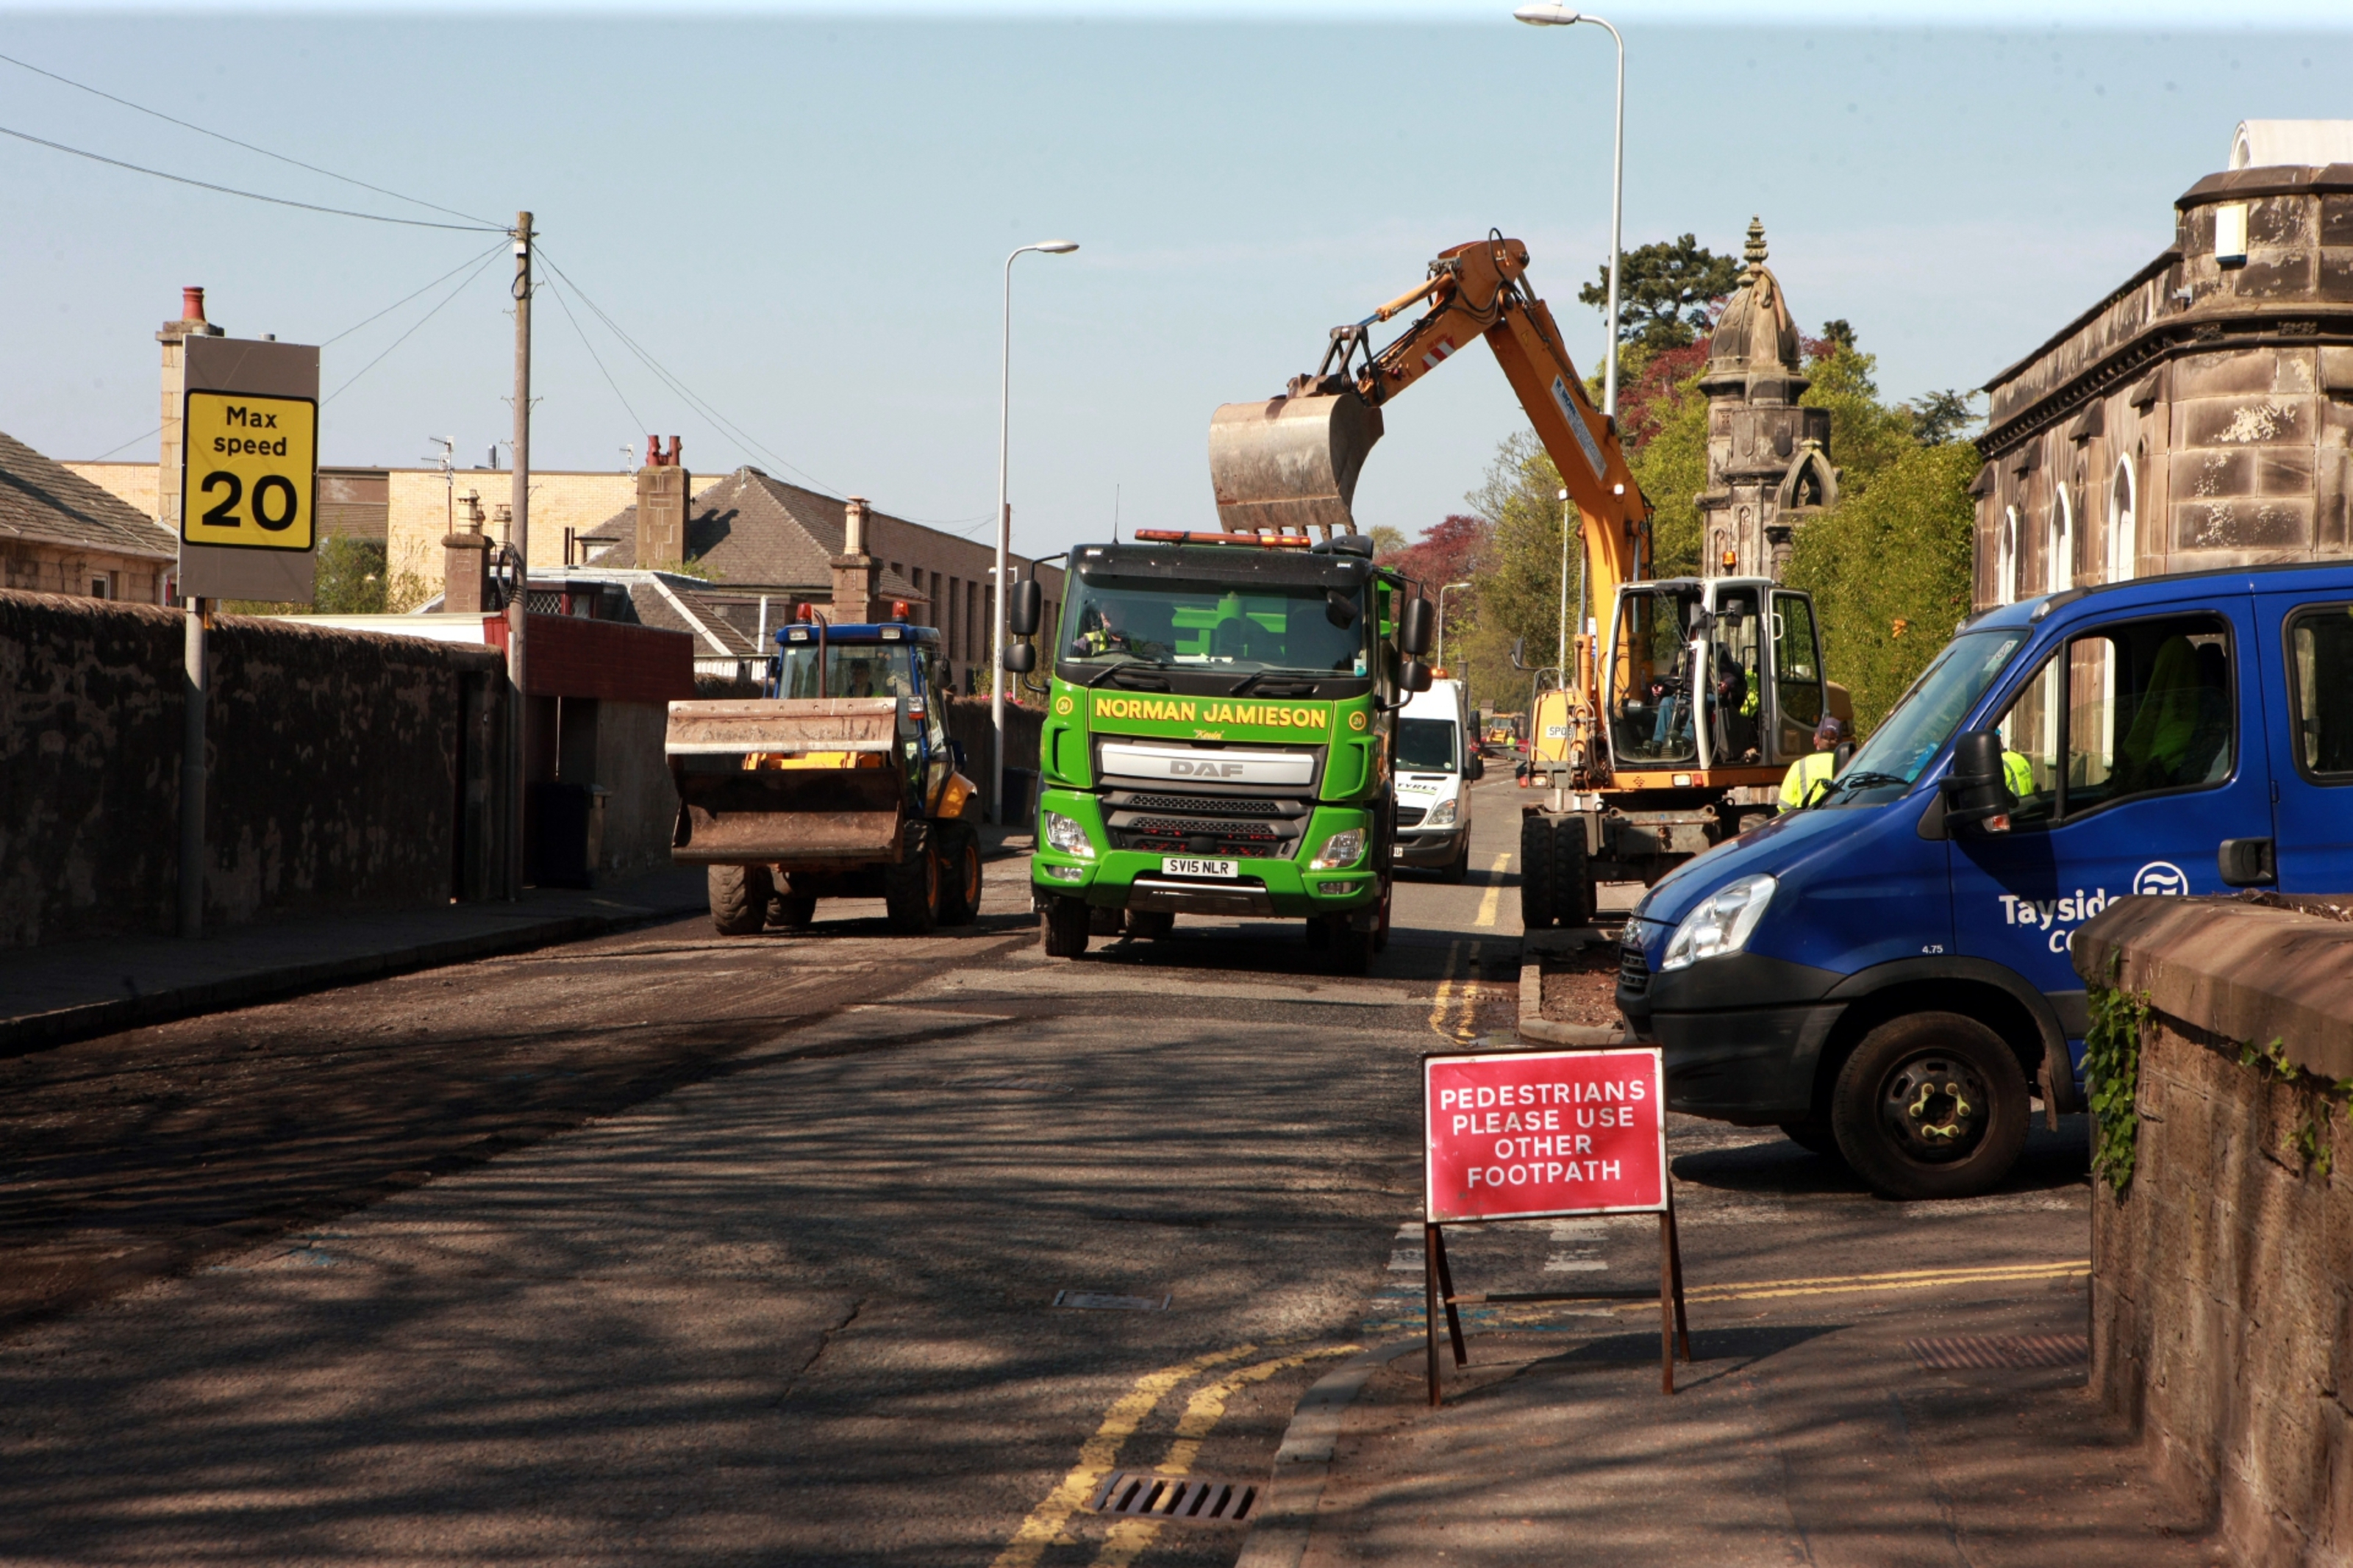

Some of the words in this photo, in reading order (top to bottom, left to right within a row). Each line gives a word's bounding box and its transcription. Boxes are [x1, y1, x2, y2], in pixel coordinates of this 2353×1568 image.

[226, 406, 277, 429] Max
[213, 437, 287, 457] speed
[201, 470, 298, 531] 20
[1096, 698, 1196, 722] NORMAN
[1202, 704, 1326, 728] JAMIESON
[1170, 761, 1243, 777] DAF
[1170, 859, 1199, 873] SV15
[1202, 862, 1229, 875] NLR
[1922, 945, 1943, 954] 4.75
[1440, 1080, 1646, 1111] PEDESTRIANS
[1453, 1109, 1560, 1136] PLEASE
[1577, 1107, 1634, 1128] USE
[1495, 1134, 1592, 1159] OTHER
[1468, 1159, 1621, 1189] FOOTPATH
